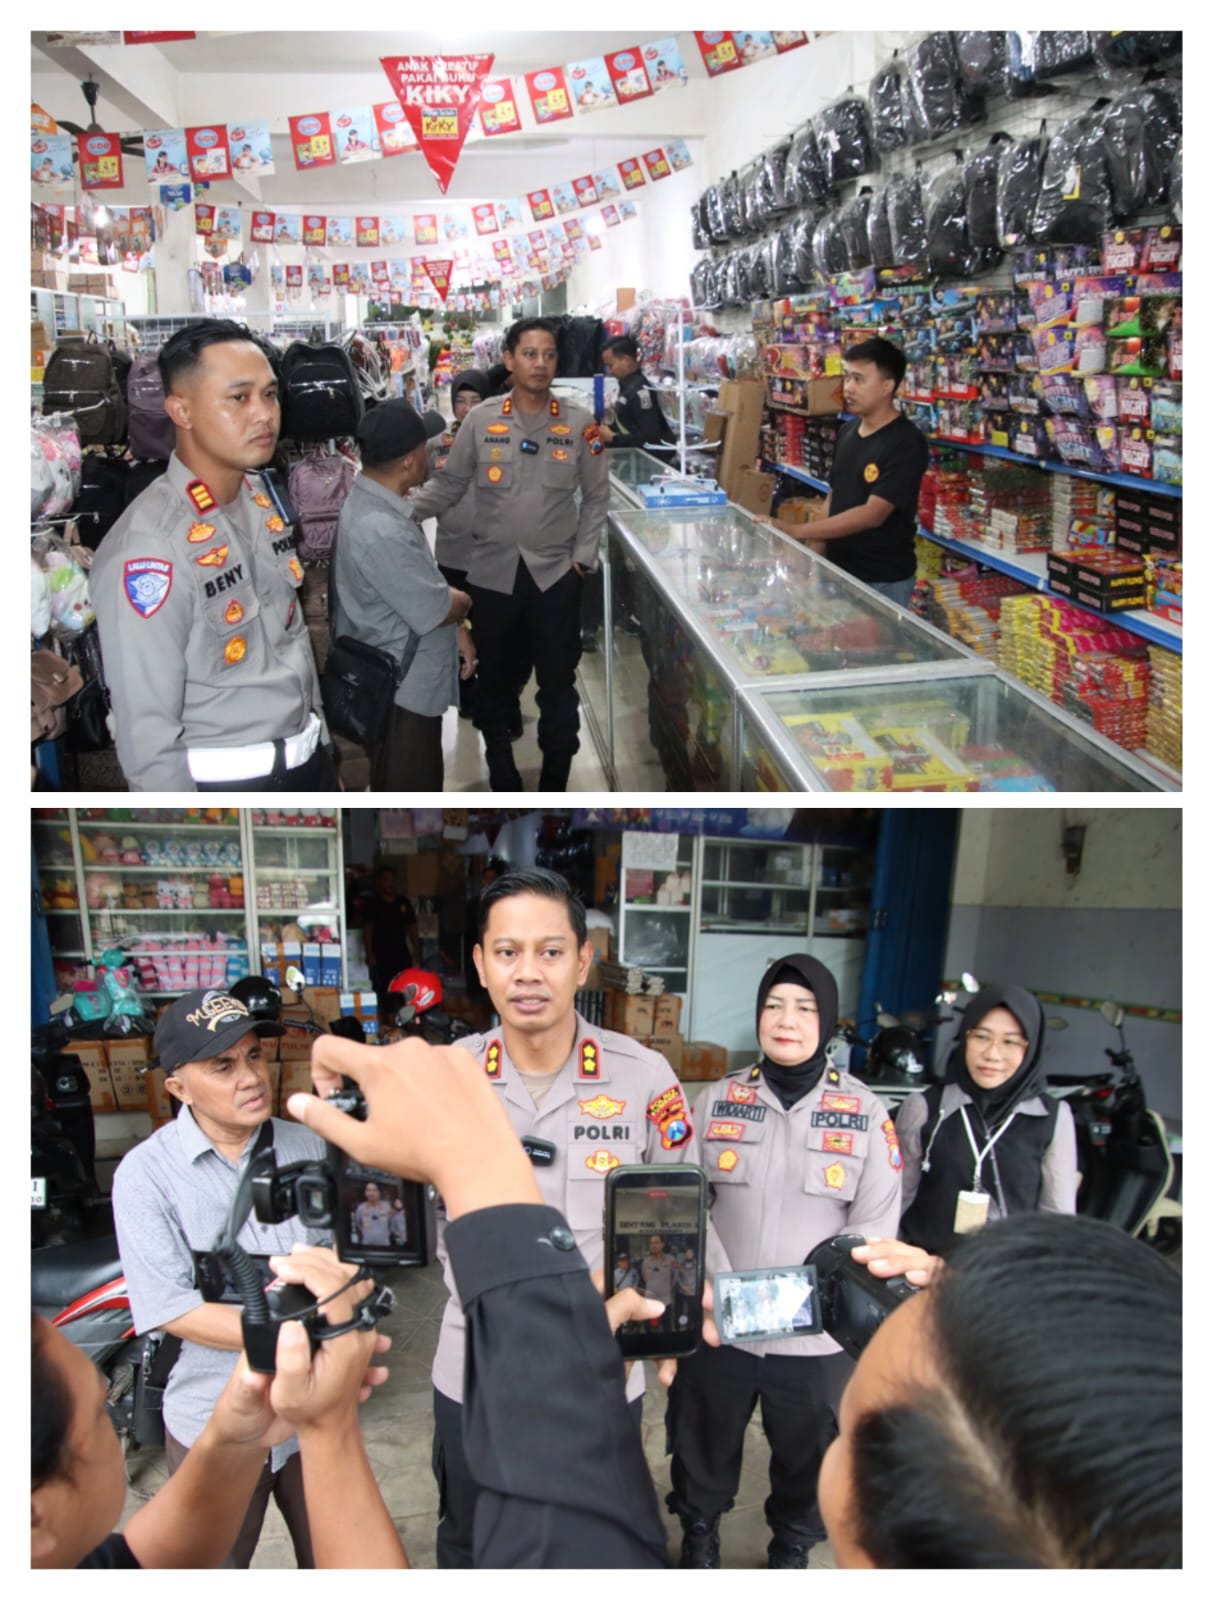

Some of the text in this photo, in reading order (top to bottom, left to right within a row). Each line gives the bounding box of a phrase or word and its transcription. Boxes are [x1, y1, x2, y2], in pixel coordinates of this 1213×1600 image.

[397, 61, 429, 72] ANAK
[406, 84, 470, 105] KIKY
[546, 437, 574, 447] POLRI
[204, 563, 245, 599] BENY
[814, 1112, 866, 1131] POLRI
[573, 1124, 630, 1141] POLRI
